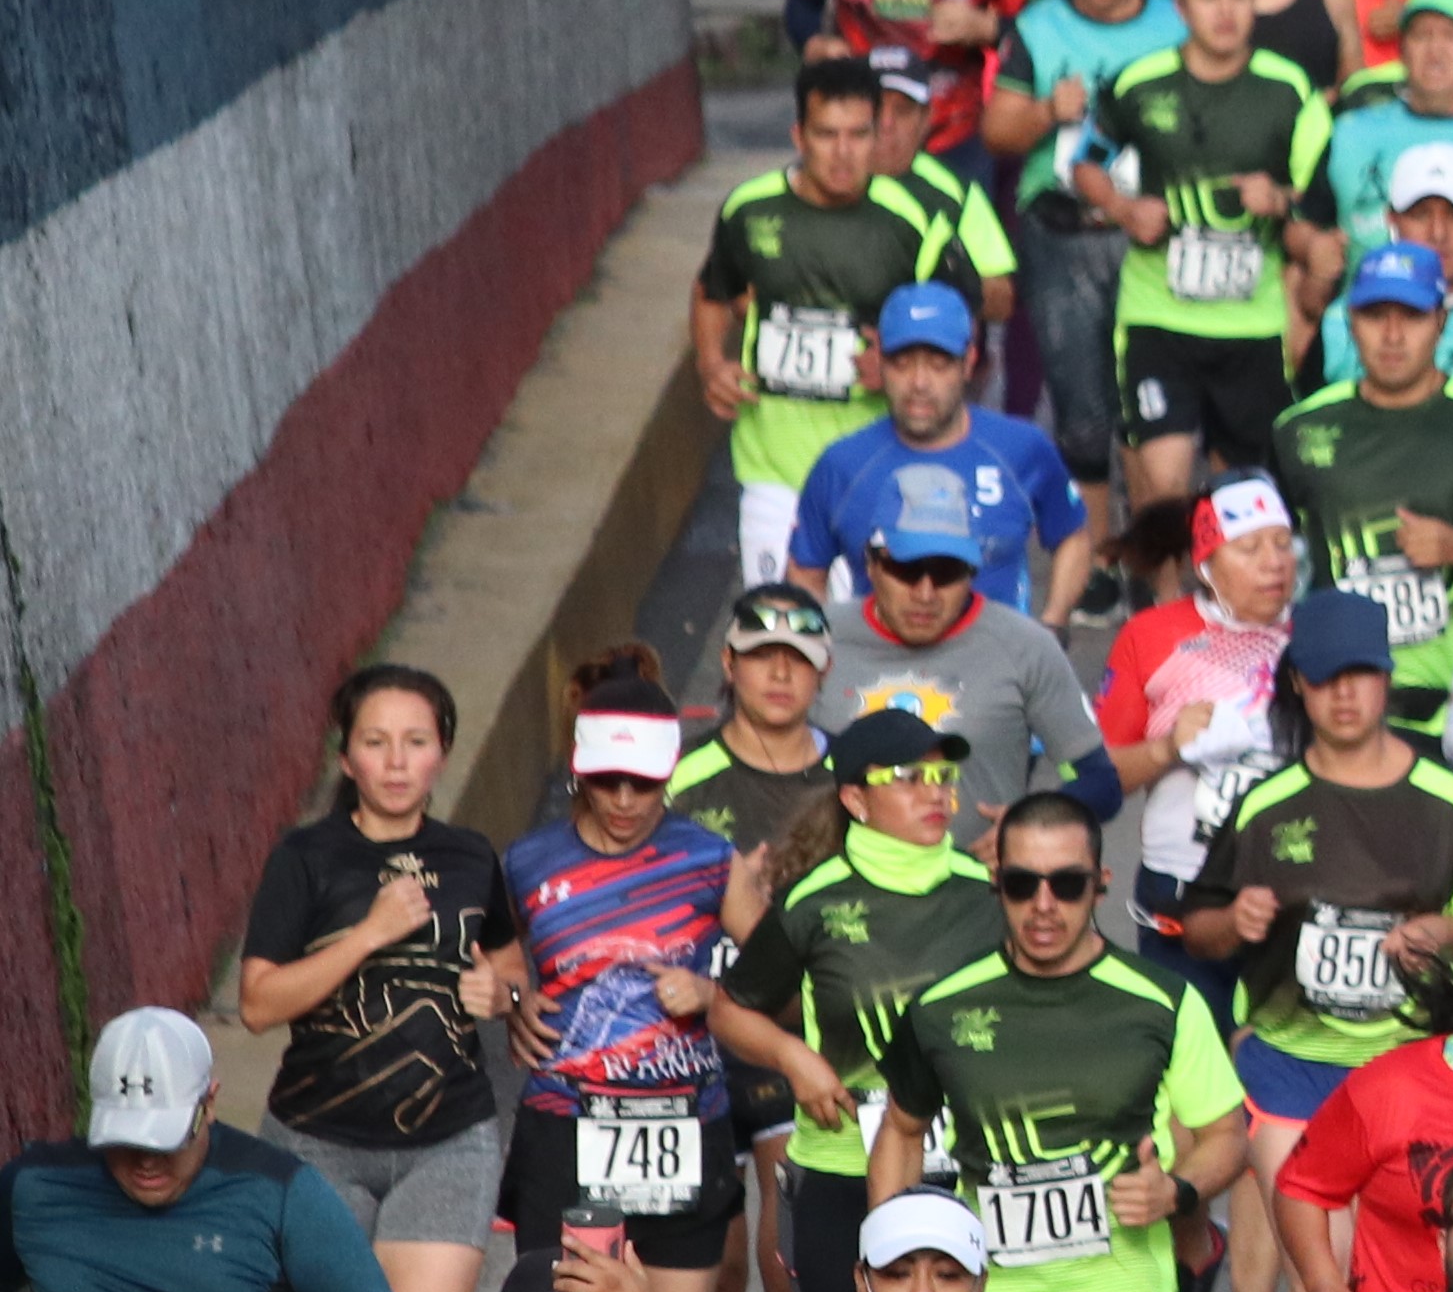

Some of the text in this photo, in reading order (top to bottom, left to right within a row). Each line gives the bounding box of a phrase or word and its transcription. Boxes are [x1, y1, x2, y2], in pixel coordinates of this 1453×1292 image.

[776, 333, 836, 377] 751
[975, 465, 1001, 507] 5
[601, 1125, 681, 1182] 748
[988, 1181, 1101, 1247] 1704
